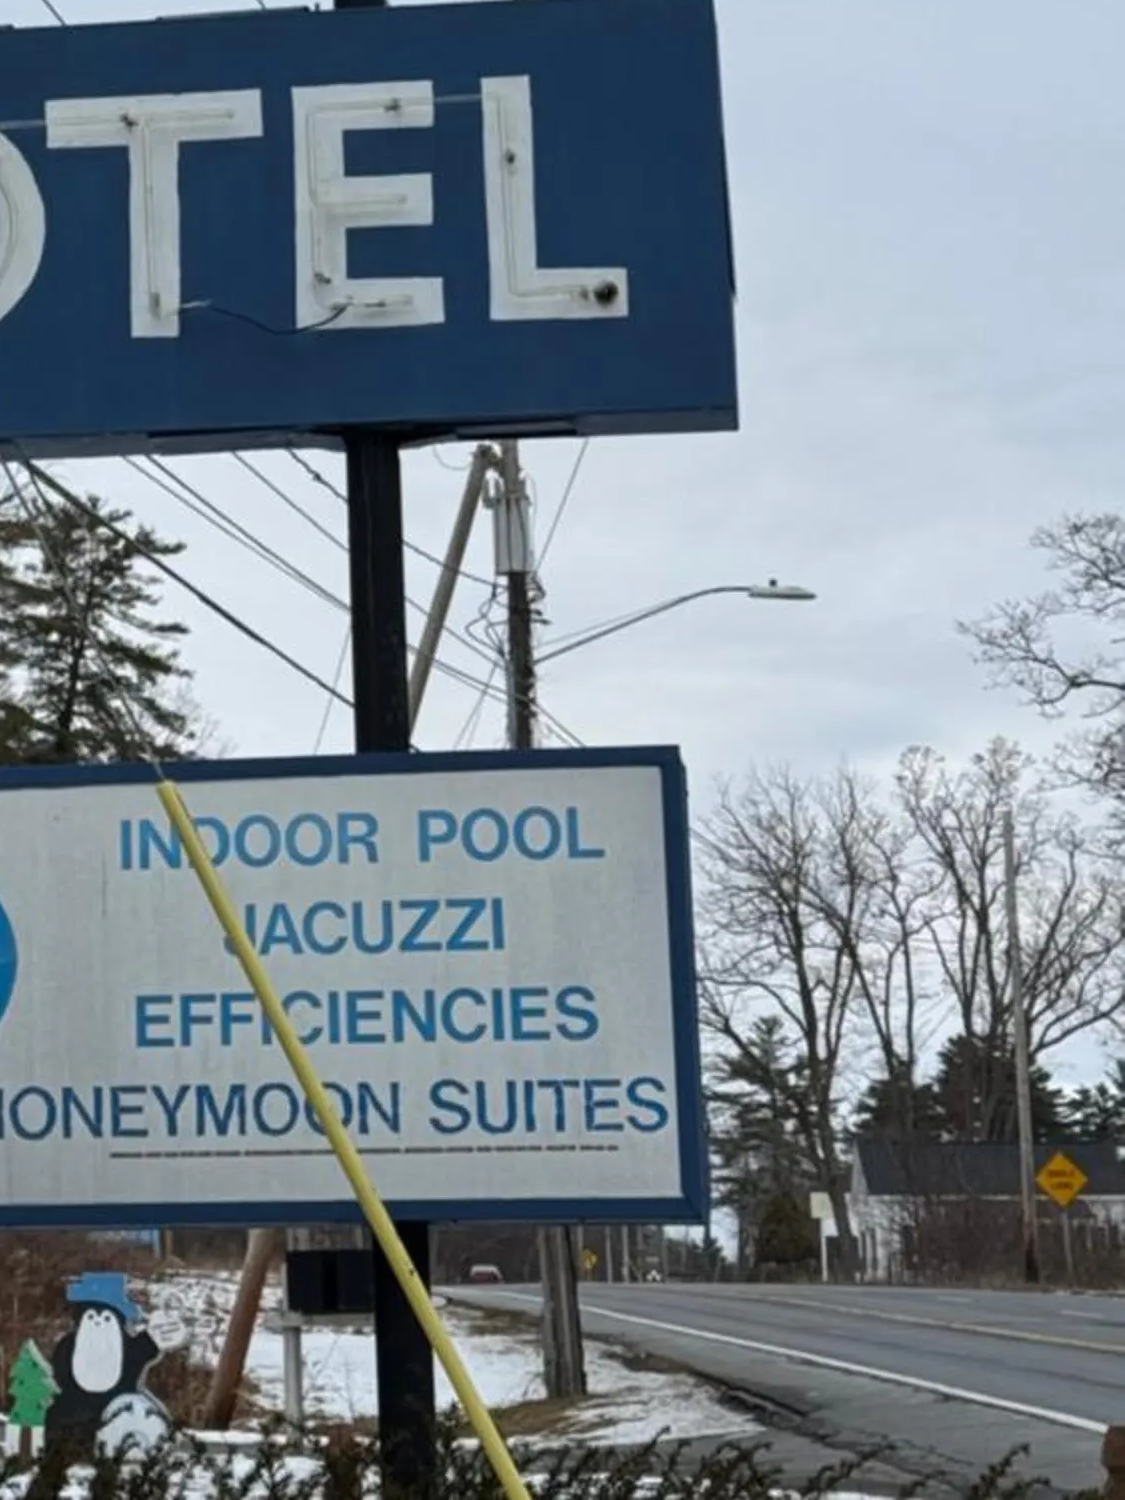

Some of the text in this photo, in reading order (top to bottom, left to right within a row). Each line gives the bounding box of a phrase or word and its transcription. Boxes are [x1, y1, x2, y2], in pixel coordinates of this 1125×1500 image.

[120, 806, 605, 871] INDOOR POOL
[223, 897, 505, 957] JACUZZI
[134, 986, 599, 1048] EFFICIENCIES
[429, 1076, 669, 1134] SUITES
